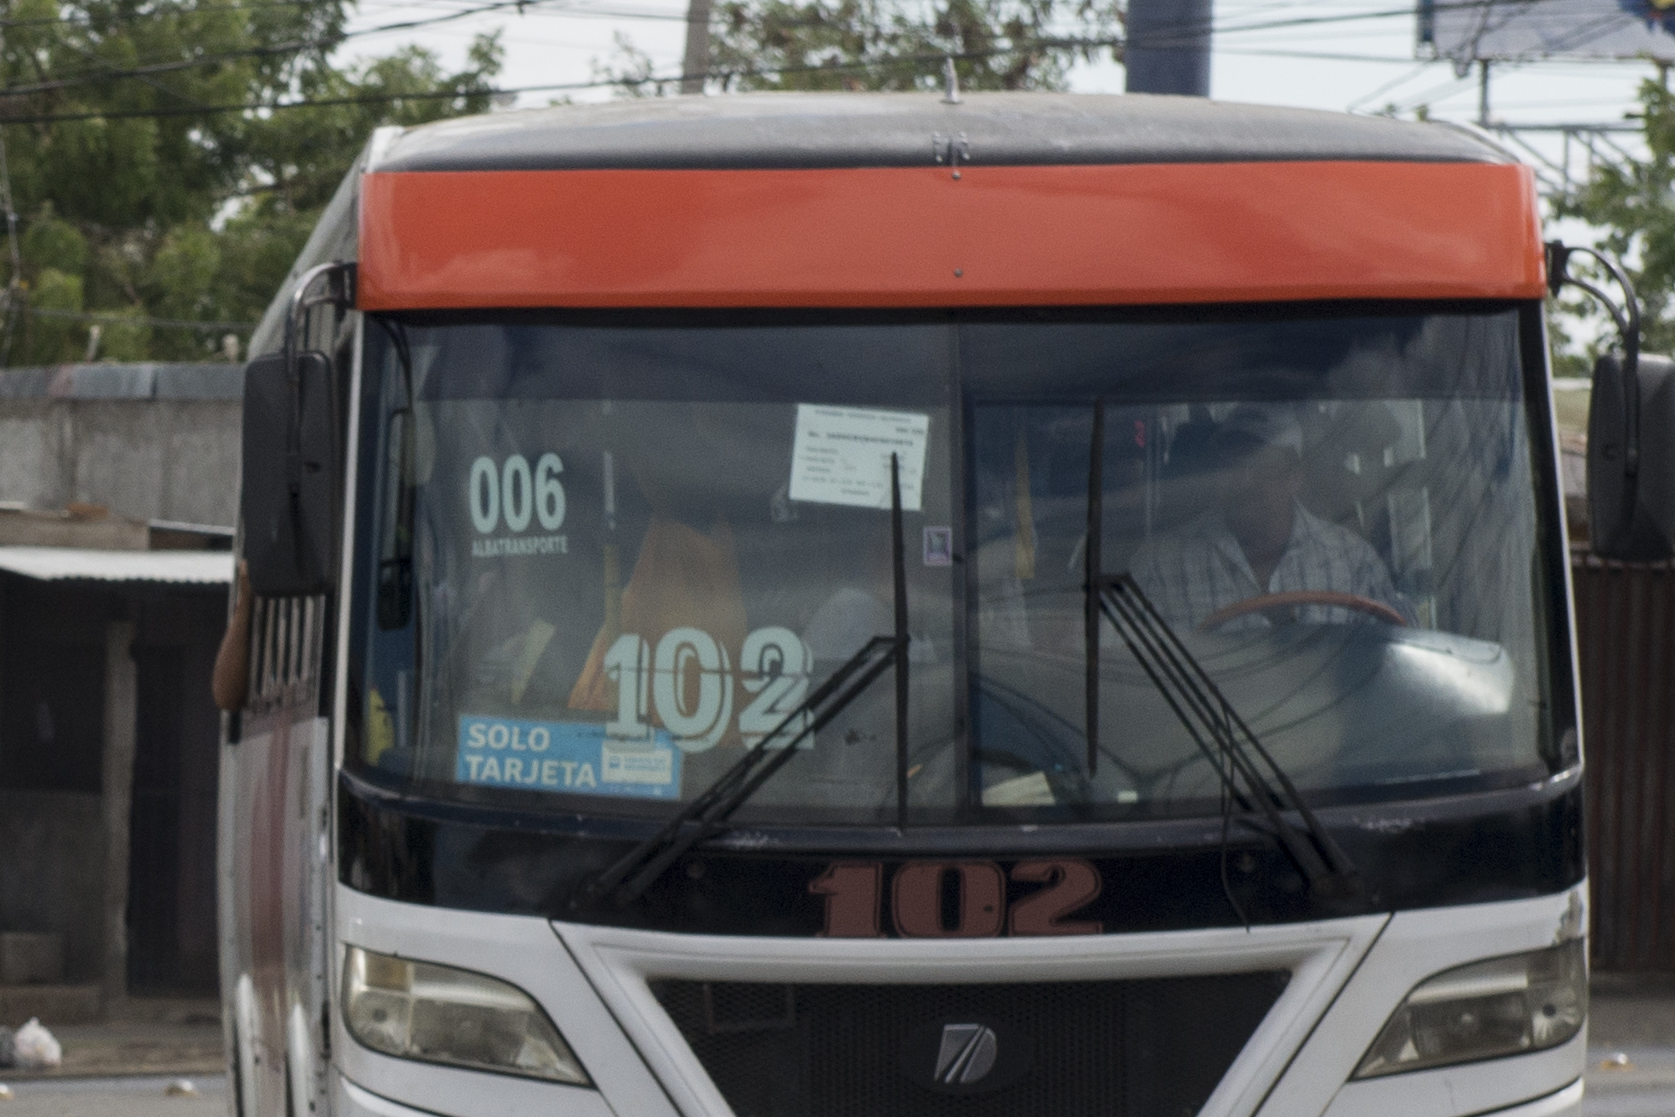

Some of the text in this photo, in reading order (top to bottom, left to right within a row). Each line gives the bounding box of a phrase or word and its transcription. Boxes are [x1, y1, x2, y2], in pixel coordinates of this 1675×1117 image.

[469, 452, 566, 534] 006
[604, 626, 815, 753] 102
[465, 754, 598, 789] TARJETA
[467, 722, 551, 752] SOLO
[808, 858, 1103, 938] 102
